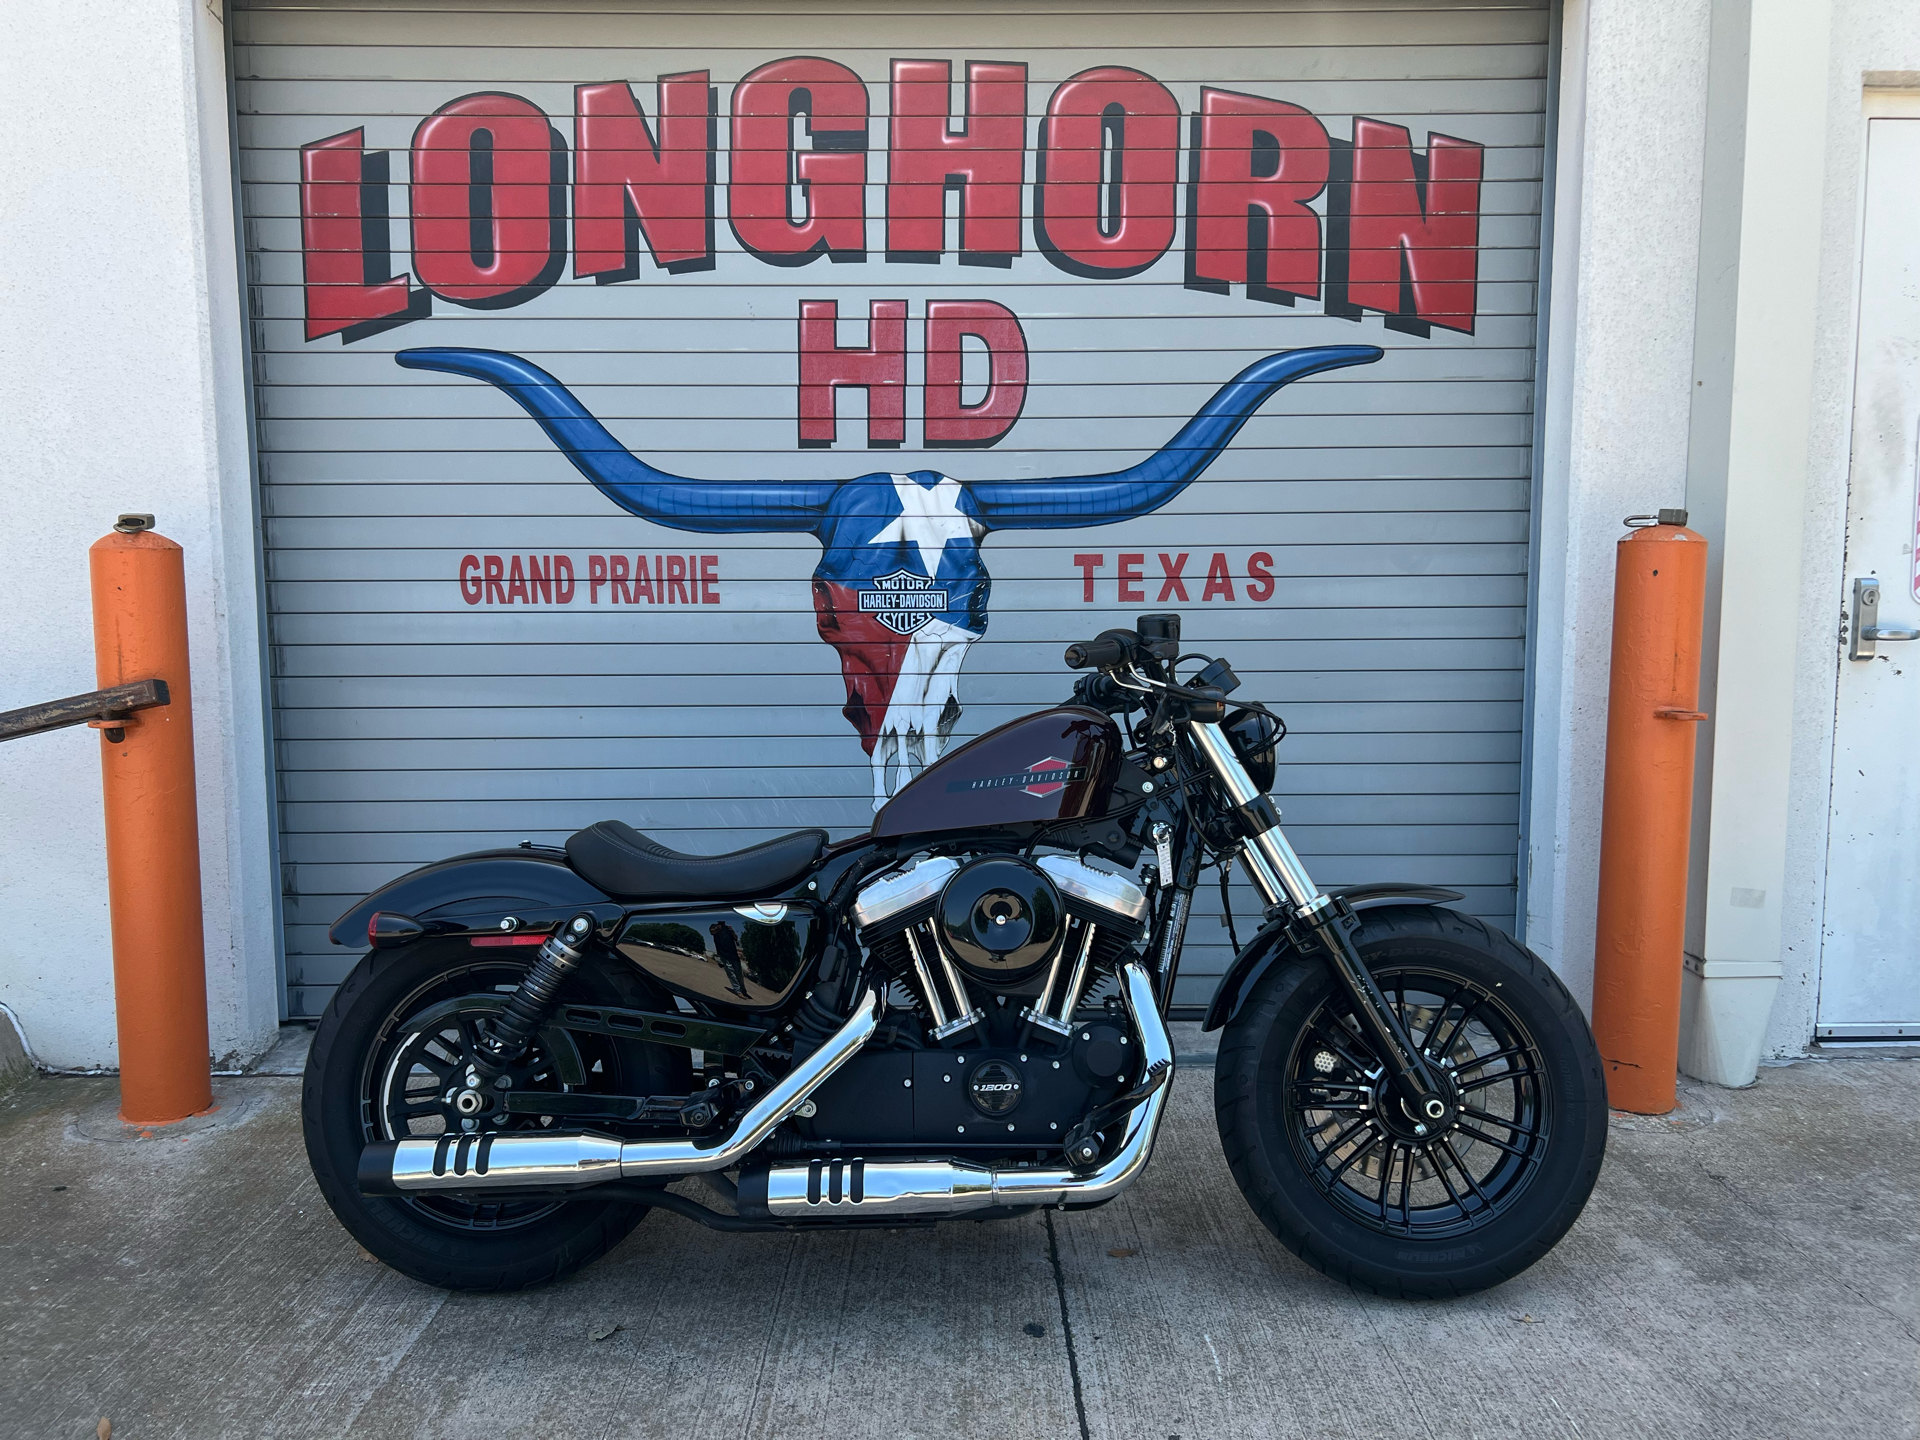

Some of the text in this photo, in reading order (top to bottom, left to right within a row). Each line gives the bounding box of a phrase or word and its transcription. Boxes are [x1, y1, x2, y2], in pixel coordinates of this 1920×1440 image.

[300, 56, 1484, 344] LONGHORN
[798, 299, 1029, 449] HD
[459, 552, 1275, 605] GRAND PRAIRIE TEXAS
[882, 575, 924, 590] MOTOR
[863, 594, 943, 609] HARLEY-DAVIDSON
[882, 613, 925, 632] CYCLES
[971, 770, 1079, 789] HARLEY-DAVIDSON
[352, 1184, 445, 1253] MICHELI
